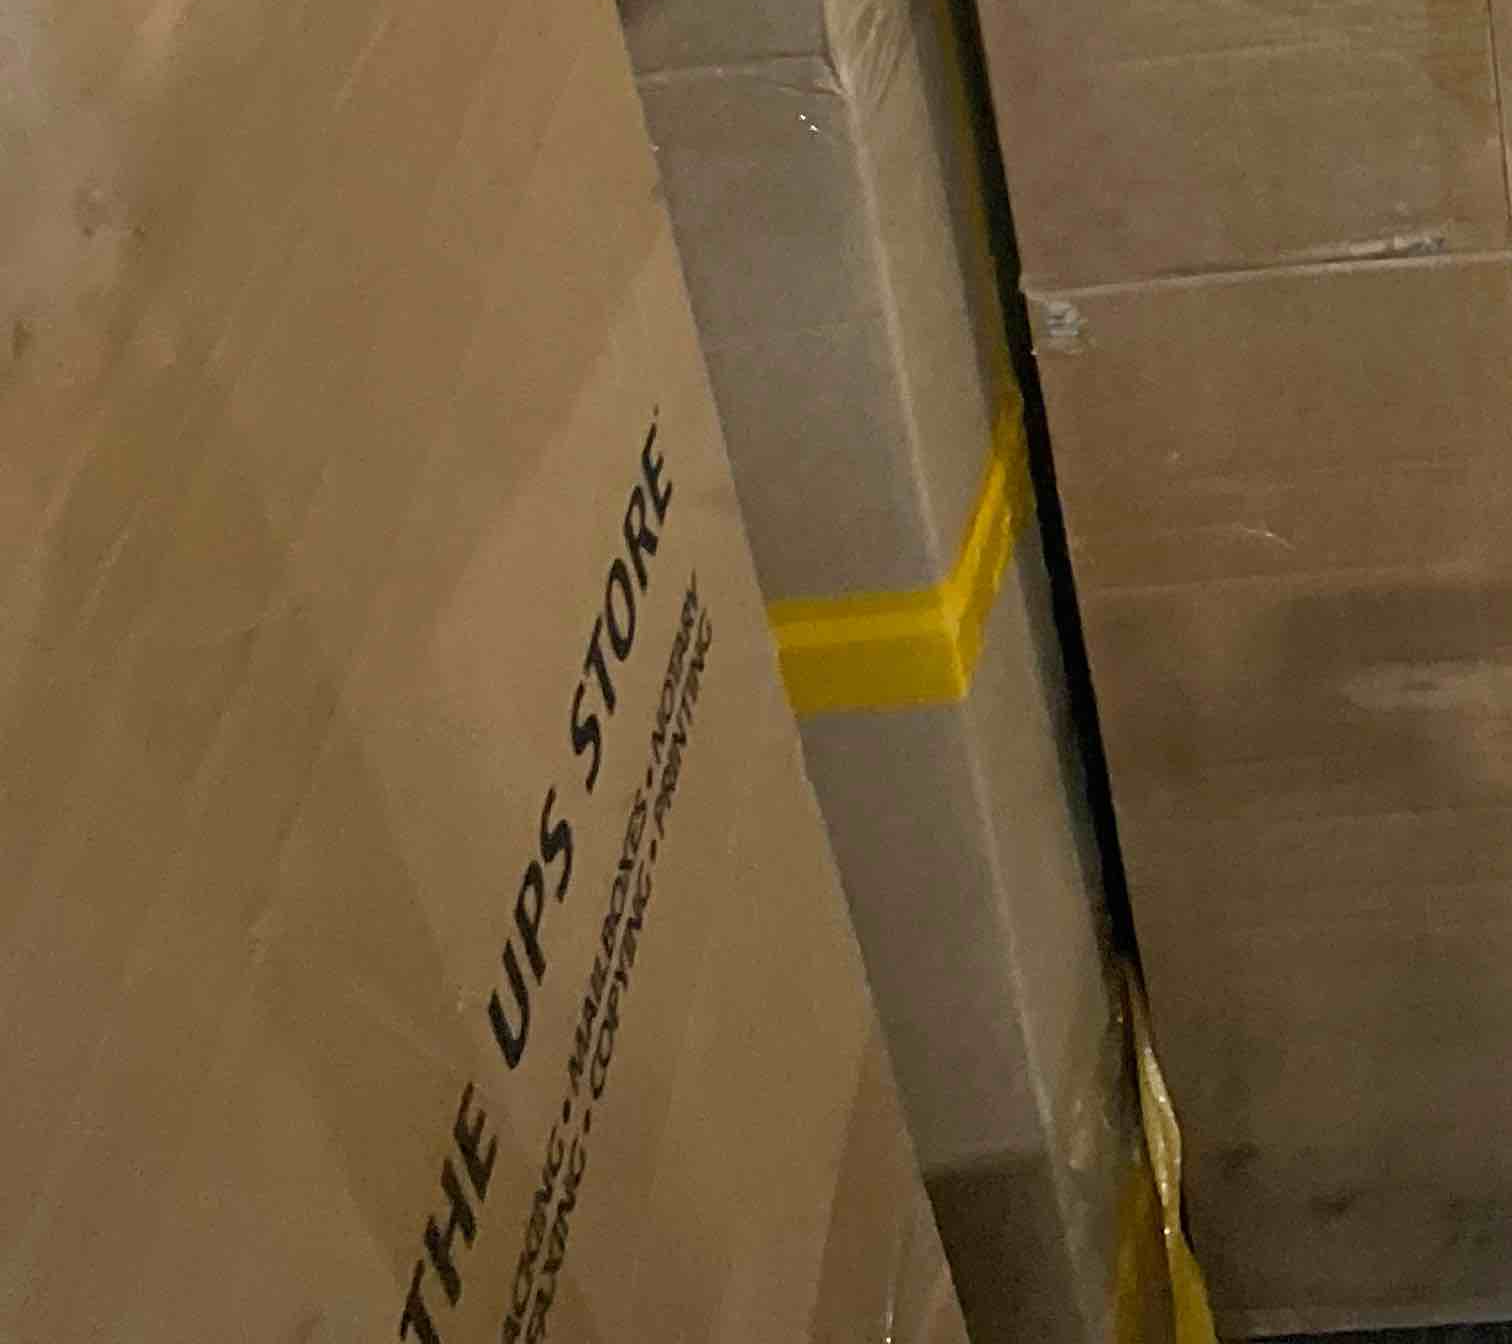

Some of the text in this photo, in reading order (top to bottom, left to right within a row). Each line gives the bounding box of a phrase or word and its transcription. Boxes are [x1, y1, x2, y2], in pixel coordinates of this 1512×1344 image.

[400, 423, 673, 1344] THE UPS STORE
[568, 788, 648, 1098] MAILBOXES
[590, 859, 652, 1101] COPYING
[652, 608, 713, 840] PRINTING
